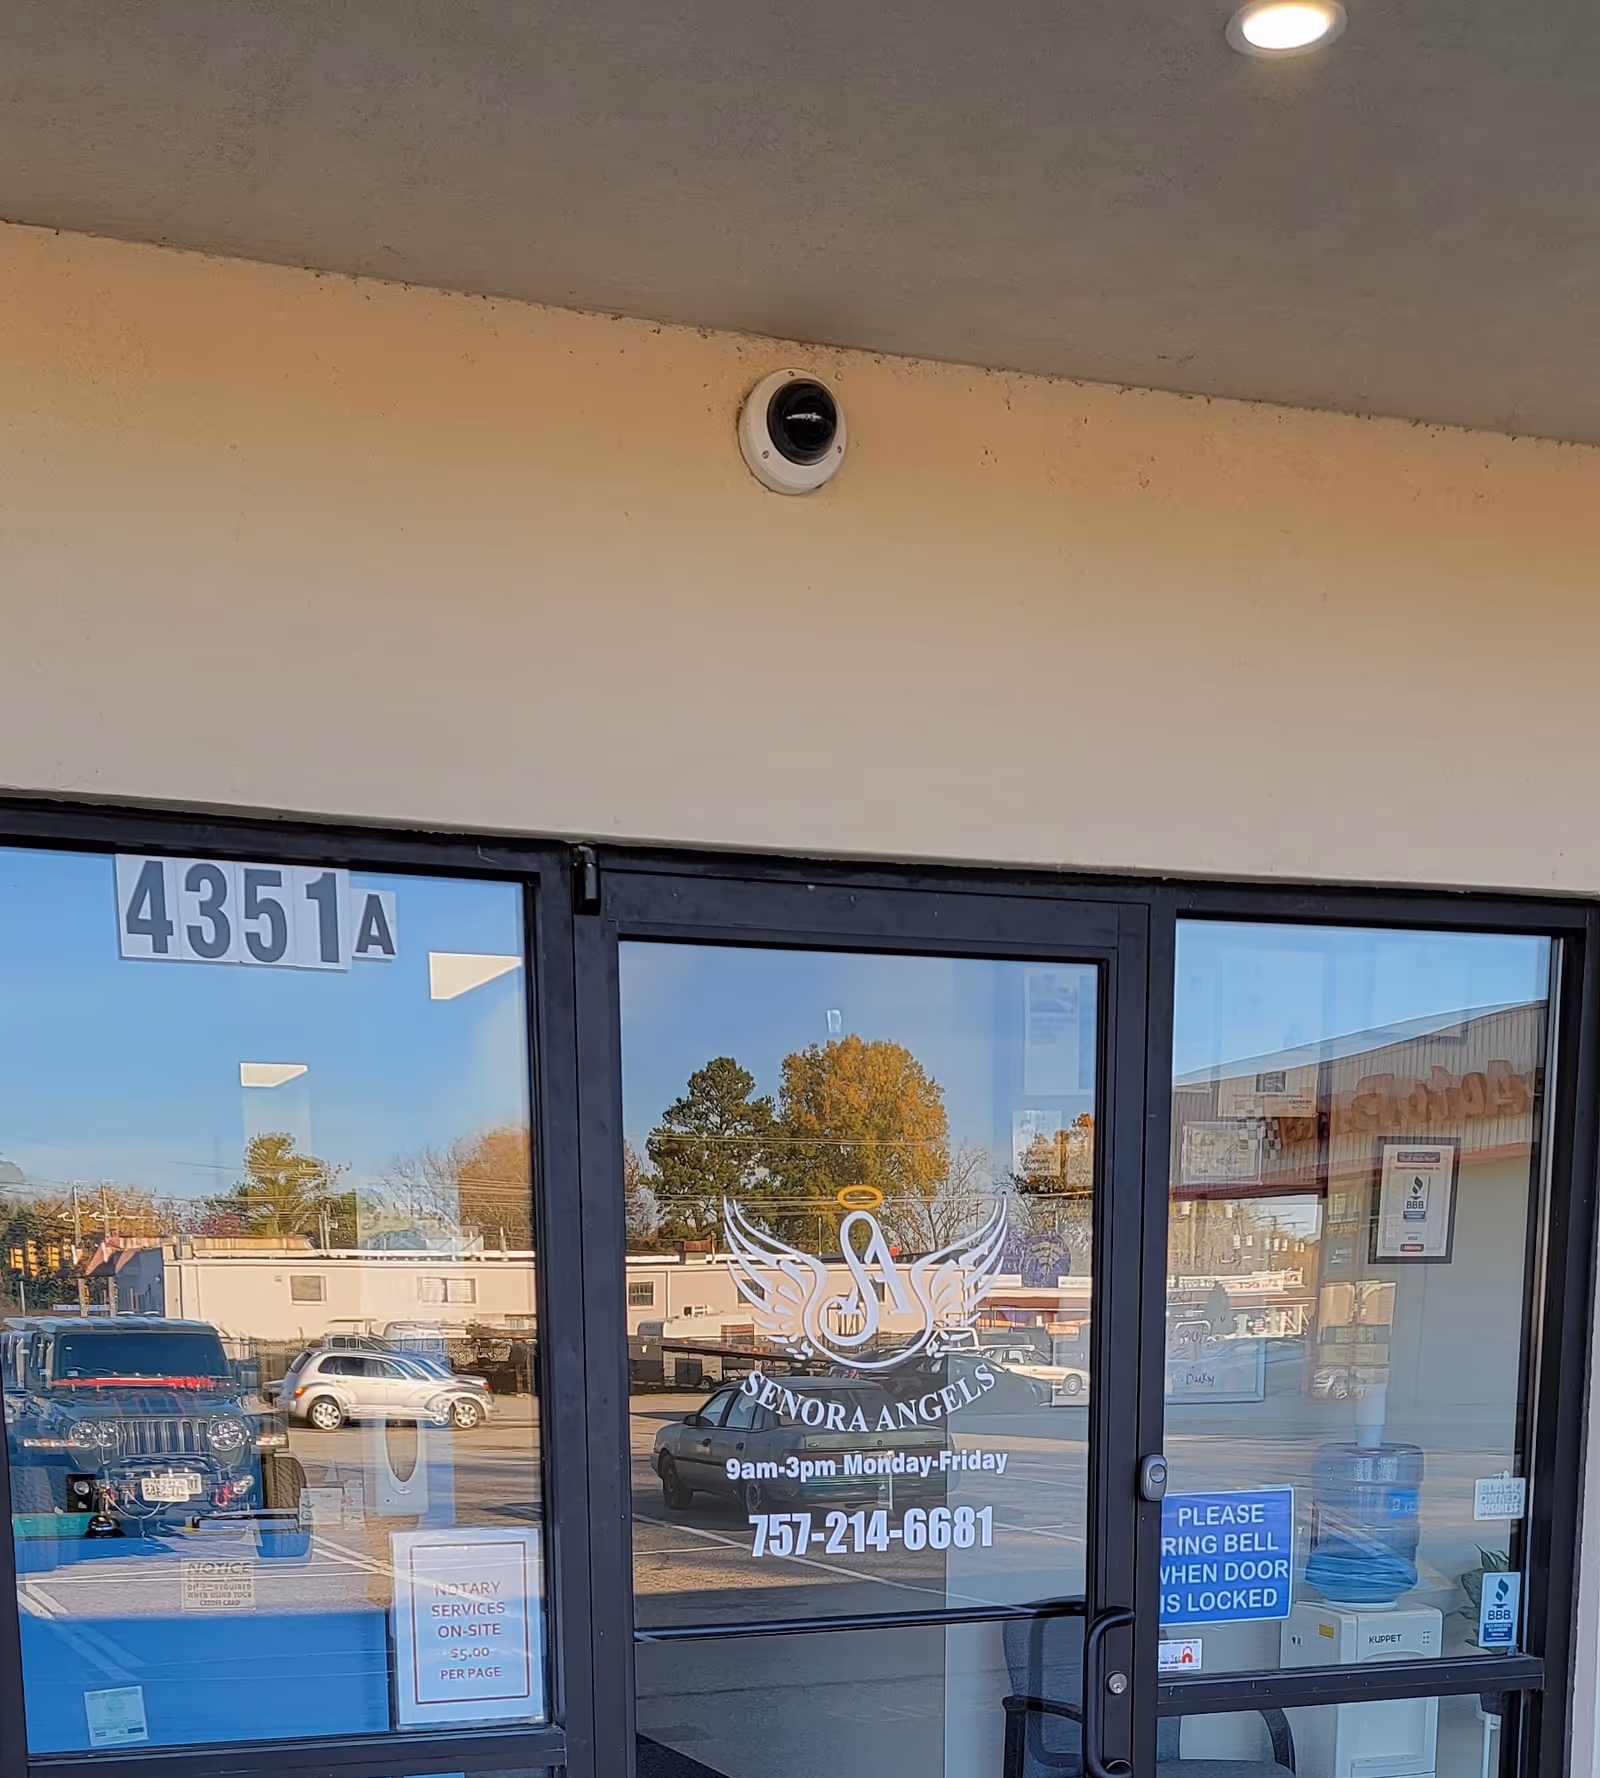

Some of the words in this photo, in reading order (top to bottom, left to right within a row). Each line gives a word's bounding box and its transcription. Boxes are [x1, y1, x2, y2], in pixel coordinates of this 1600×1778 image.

[740, 1370, 869, 1432] SENORA
[875, 1363, 996, 1431] ANGELS
[726, 1456, 836, 1482] 9am-3pm
[843, 1449, 1008, 1477] Monday-Friday
[1481, 1483, 1520, 1493] BLACK
[1481, 1493, 1519, 1503] OWNED
[1179, 1504, 1264, 1527] PLEASE
[1480, 1504, 1520, 1514] BUSINESS
[748, 1505, 993, 1557] 757-214-6681
[1162, 1535, 1217, 1556] RING
[1224, 1532, 1279, 1553] BELL
[187, 1562, 251, 1574] NOTICE
[1225, 1560, 1288, 1581] DOOR
[434, 1581, 500, 1596] NOTARY
[1160, 1594, 1180, 1614] IS
[1188, 1588, 1278, 1612] LOCKED
[432, 1601, 505, 1617] SERVICES
[1488, 1610, 1511, 1620] BBB
[438, 1623, 501, 1638] ON-SITE
[1369, 1634, 1402, 1644] KUPPET
[451, 1647, 489, 1660] $5.00
[441, 1669, 465, 1680] PER
[468, 1666, 501, 1679] PAGE
